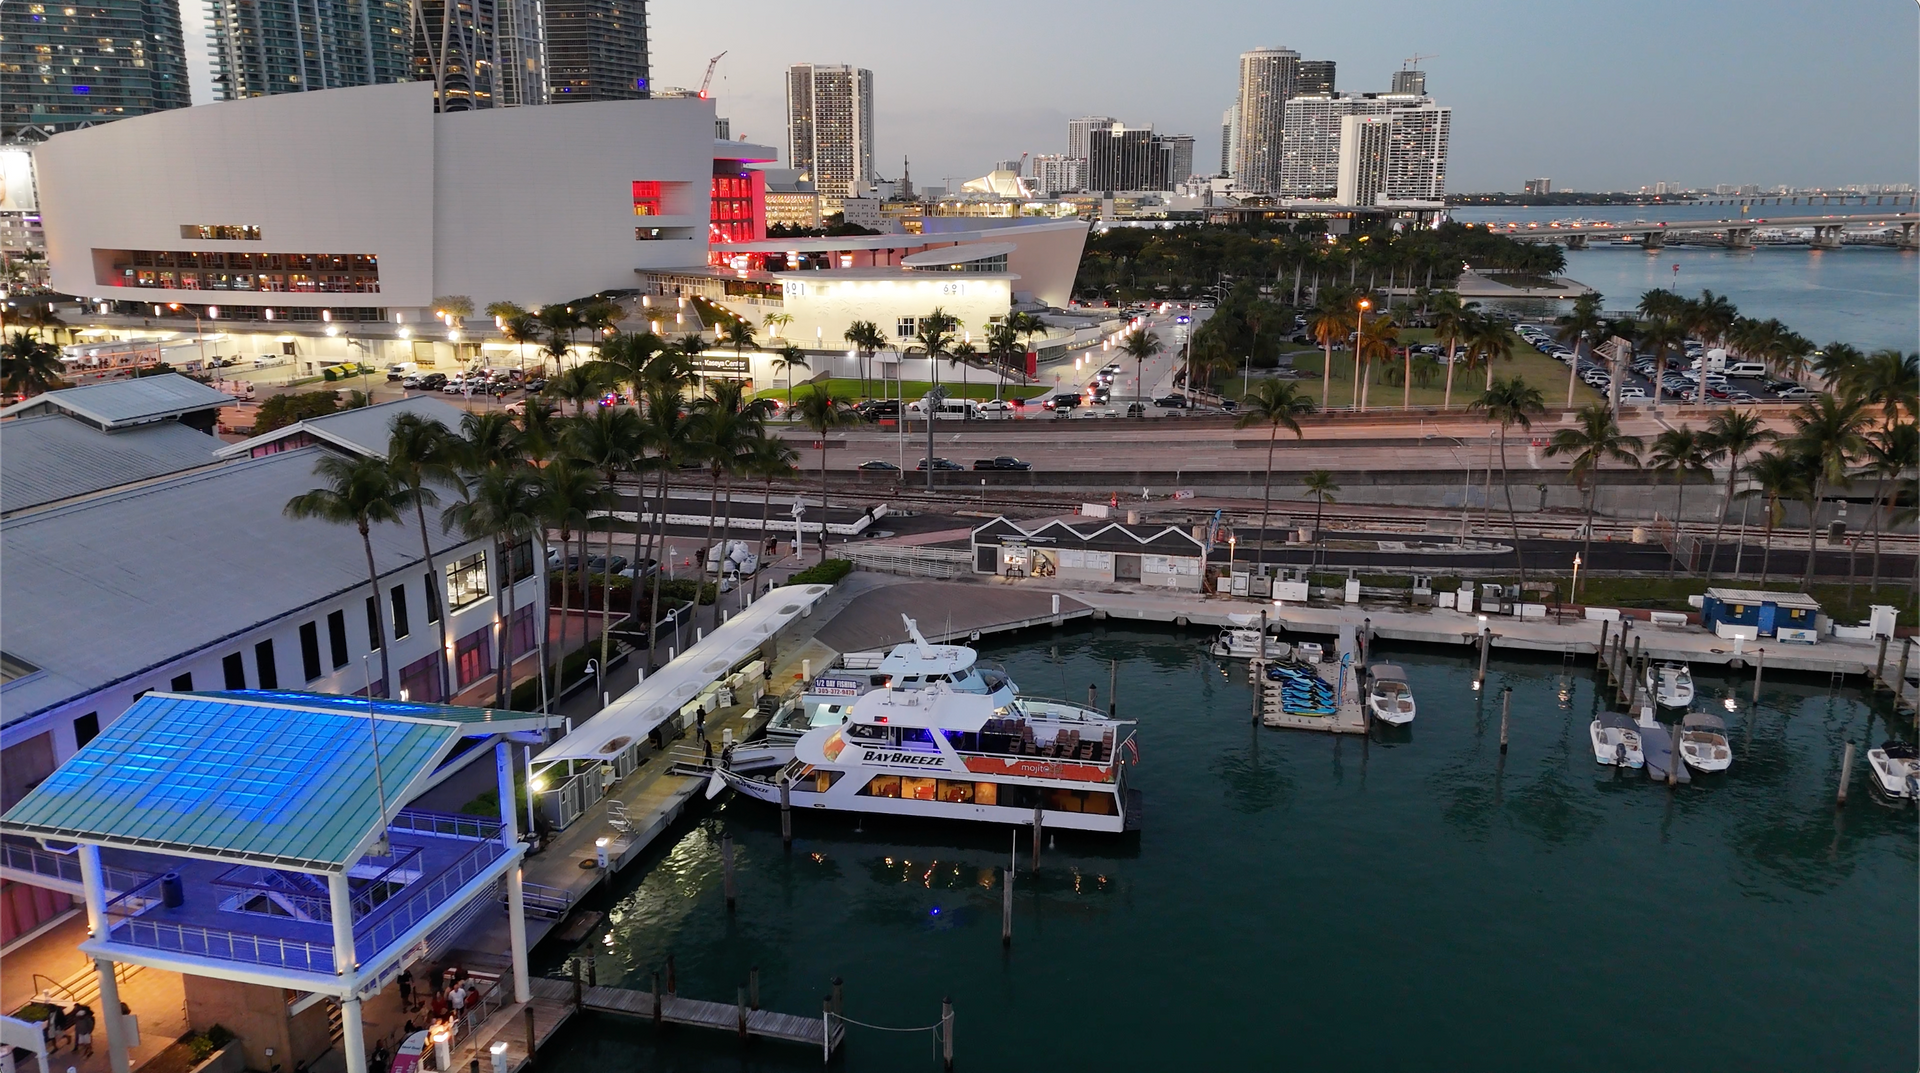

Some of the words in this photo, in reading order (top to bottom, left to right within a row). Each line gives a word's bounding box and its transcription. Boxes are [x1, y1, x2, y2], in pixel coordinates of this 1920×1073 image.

[704, 359, 725, 368] Kaseya
[816, 679, 825, 687] 1/2
[836, 680, 857, 689] FISHING
